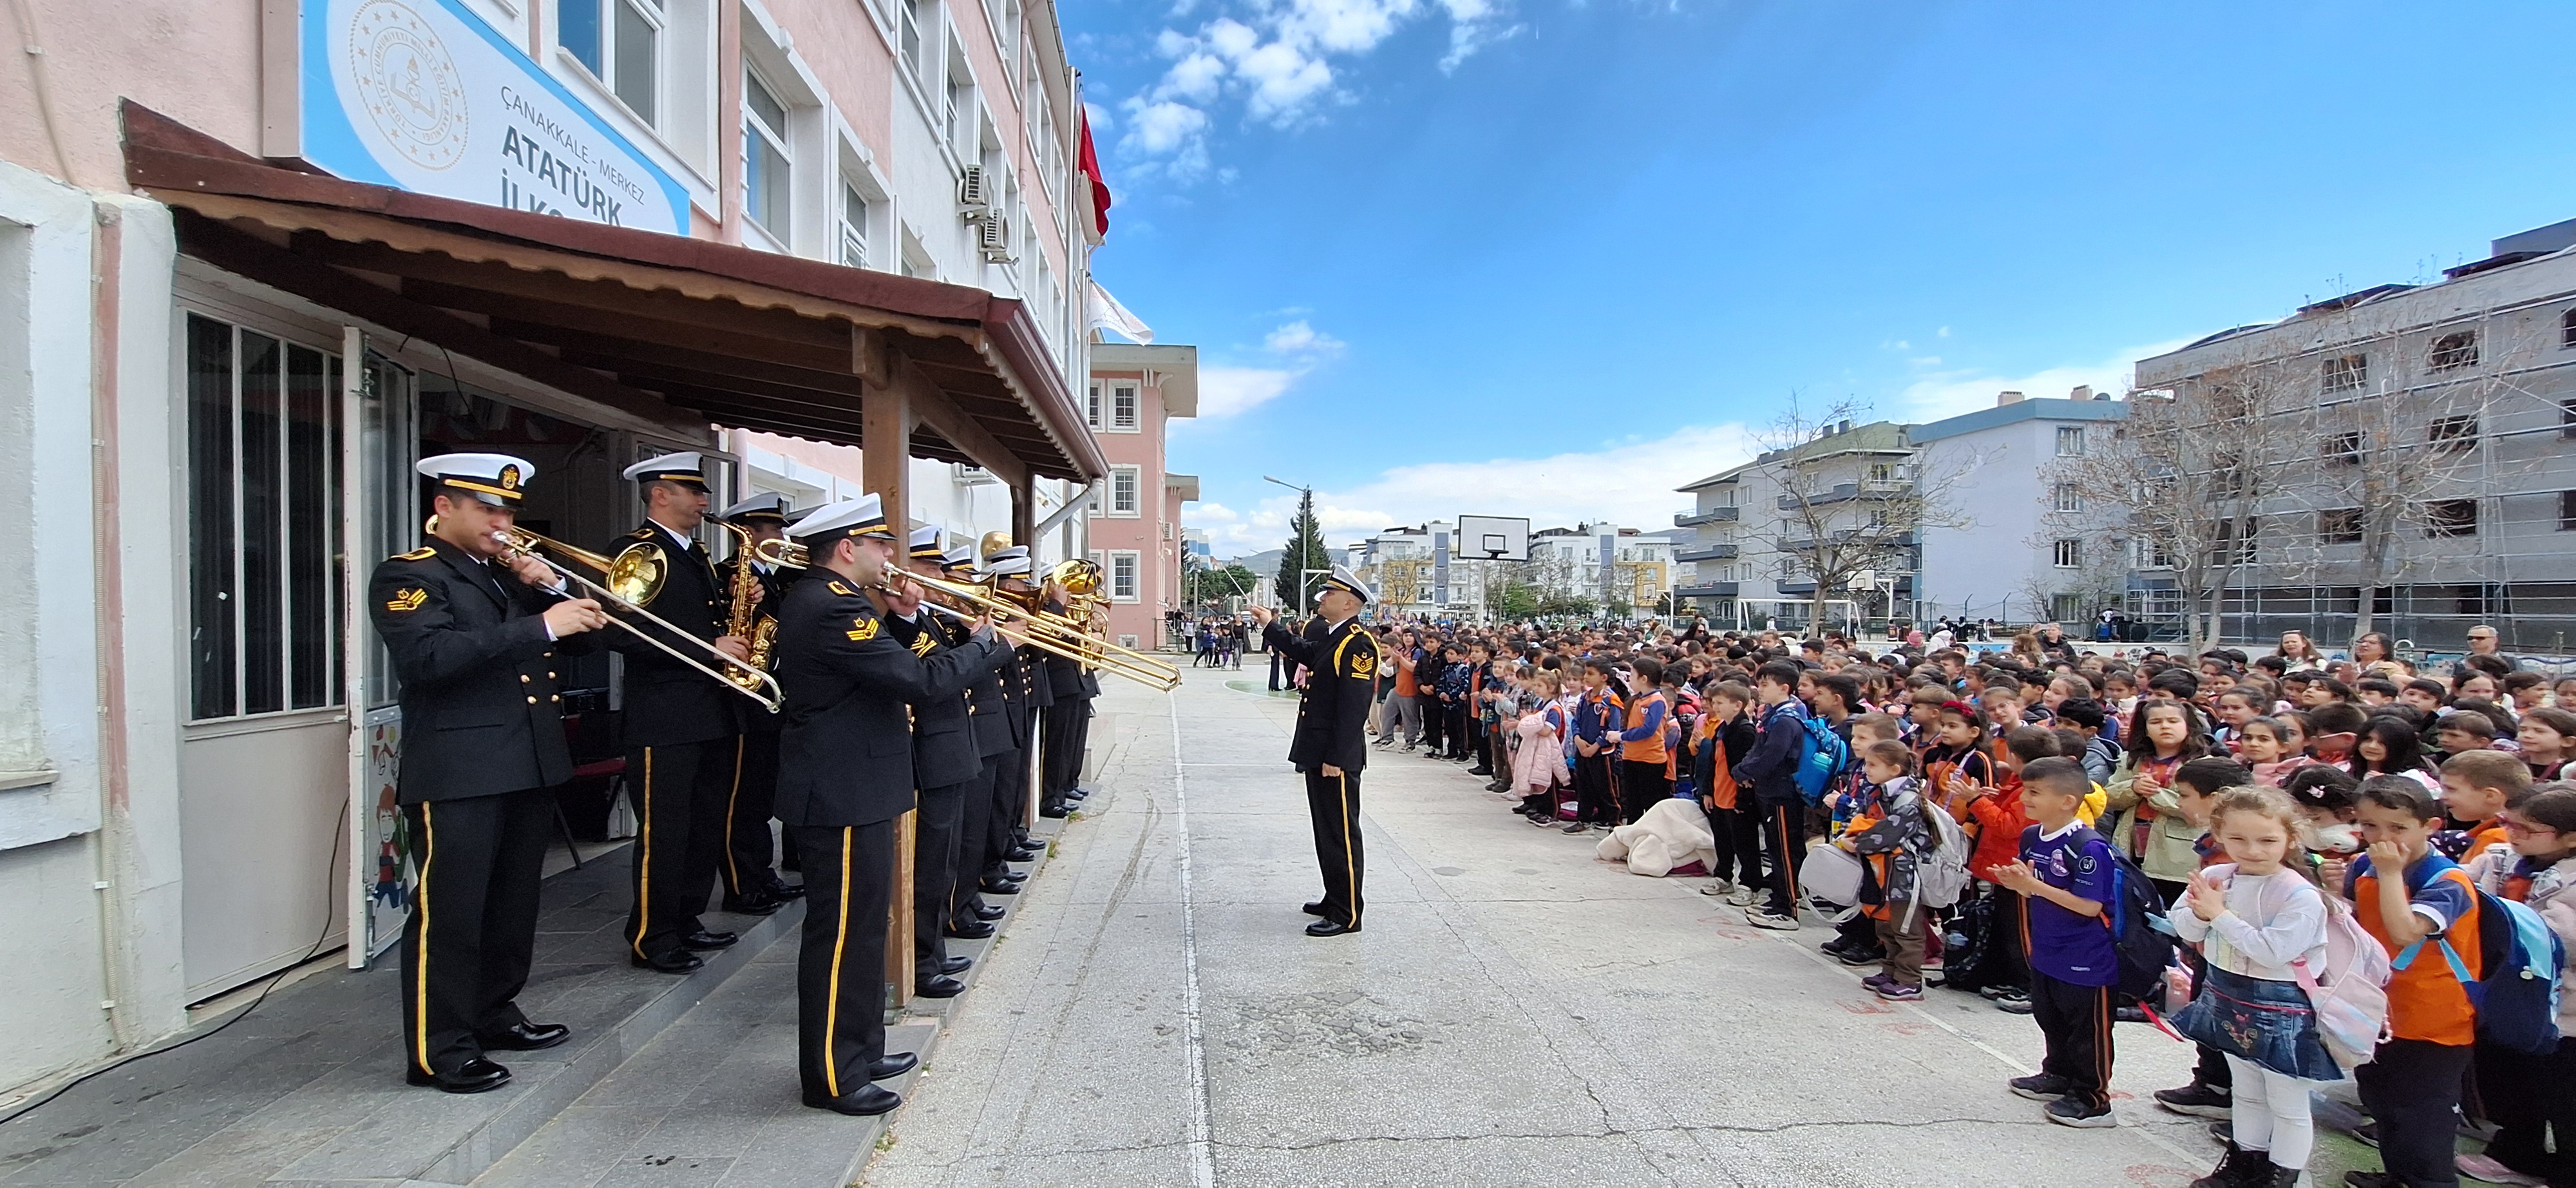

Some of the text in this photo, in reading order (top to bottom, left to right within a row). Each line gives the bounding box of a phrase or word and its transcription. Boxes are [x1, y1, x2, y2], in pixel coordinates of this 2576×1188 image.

[501, 86, 589, 164] ÇANAKKALE
[600, 158, 645, 206] MERKEZ
[502, 124, 622, 226] ATATÜRK
